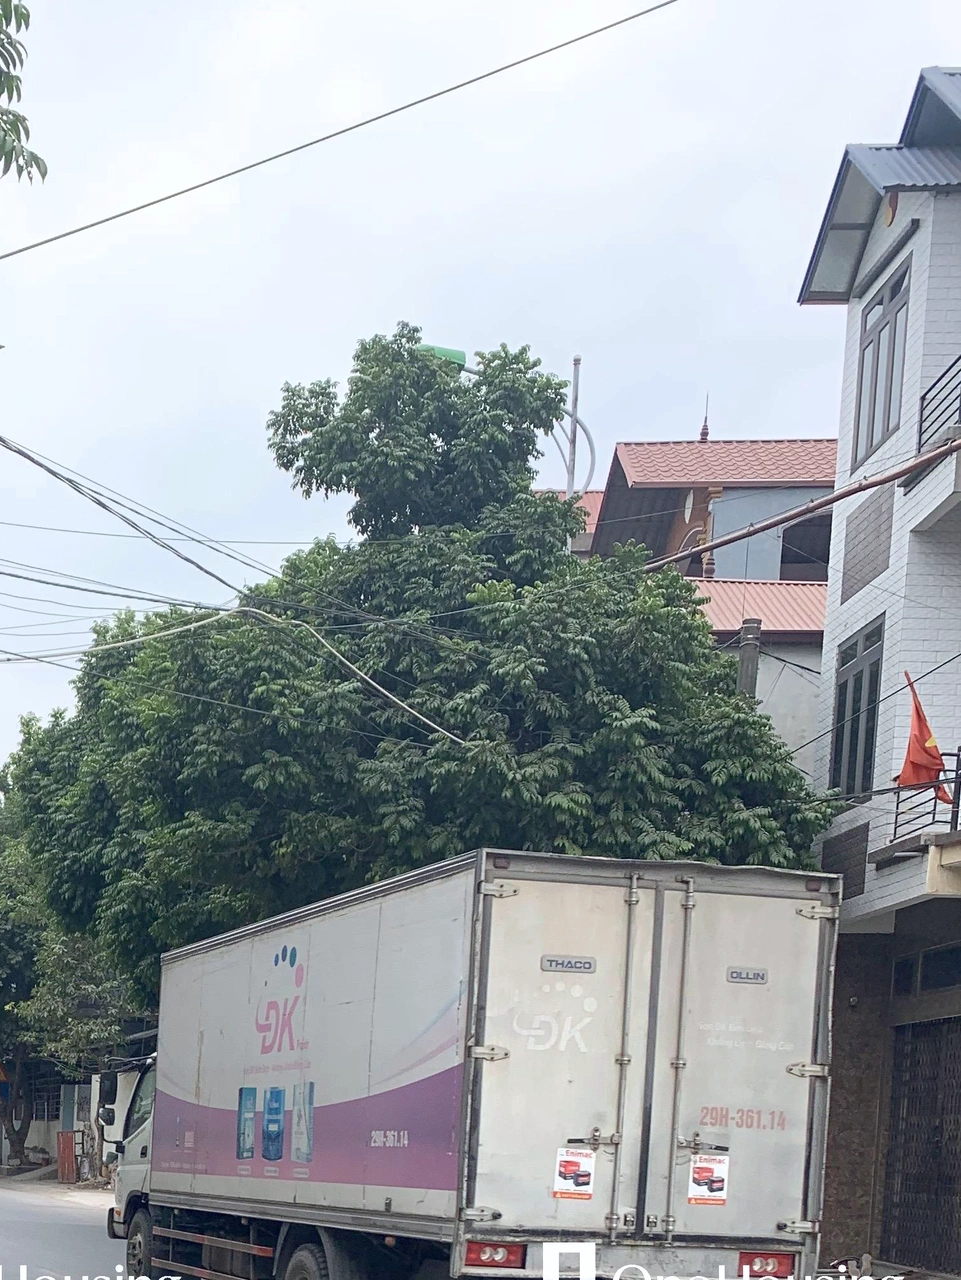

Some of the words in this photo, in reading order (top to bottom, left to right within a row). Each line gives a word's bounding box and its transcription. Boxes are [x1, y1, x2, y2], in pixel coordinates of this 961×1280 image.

[546, 958, 593, 970] THACO
[730, 970, 765, 982] OLLIN
[699, 1106, 786, 1131] 29H-361.14
